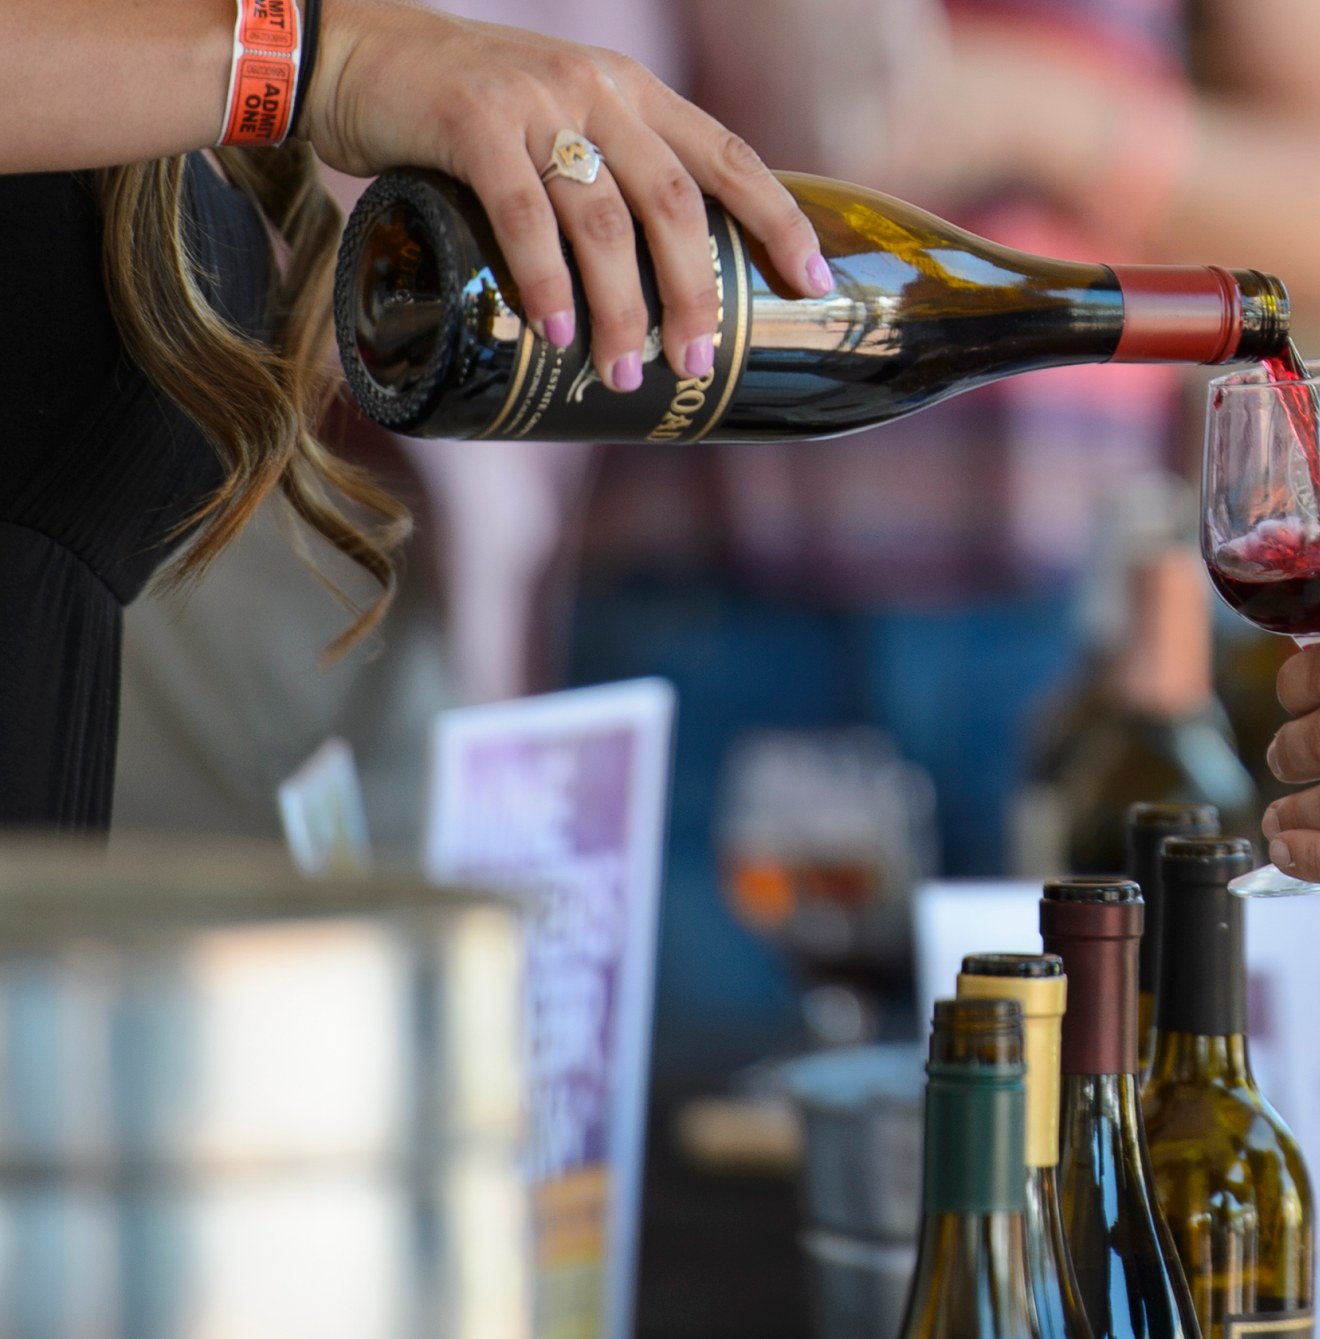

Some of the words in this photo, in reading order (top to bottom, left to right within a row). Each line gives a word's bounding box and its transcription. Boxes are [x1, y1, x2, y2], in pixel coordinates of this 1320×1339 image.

[253, 0, 268, 18] NE
[269, 0, 285, 29] MIT
[239, 94, 262, 133] ONE
[256, 82, 281, 140] ADMIT
